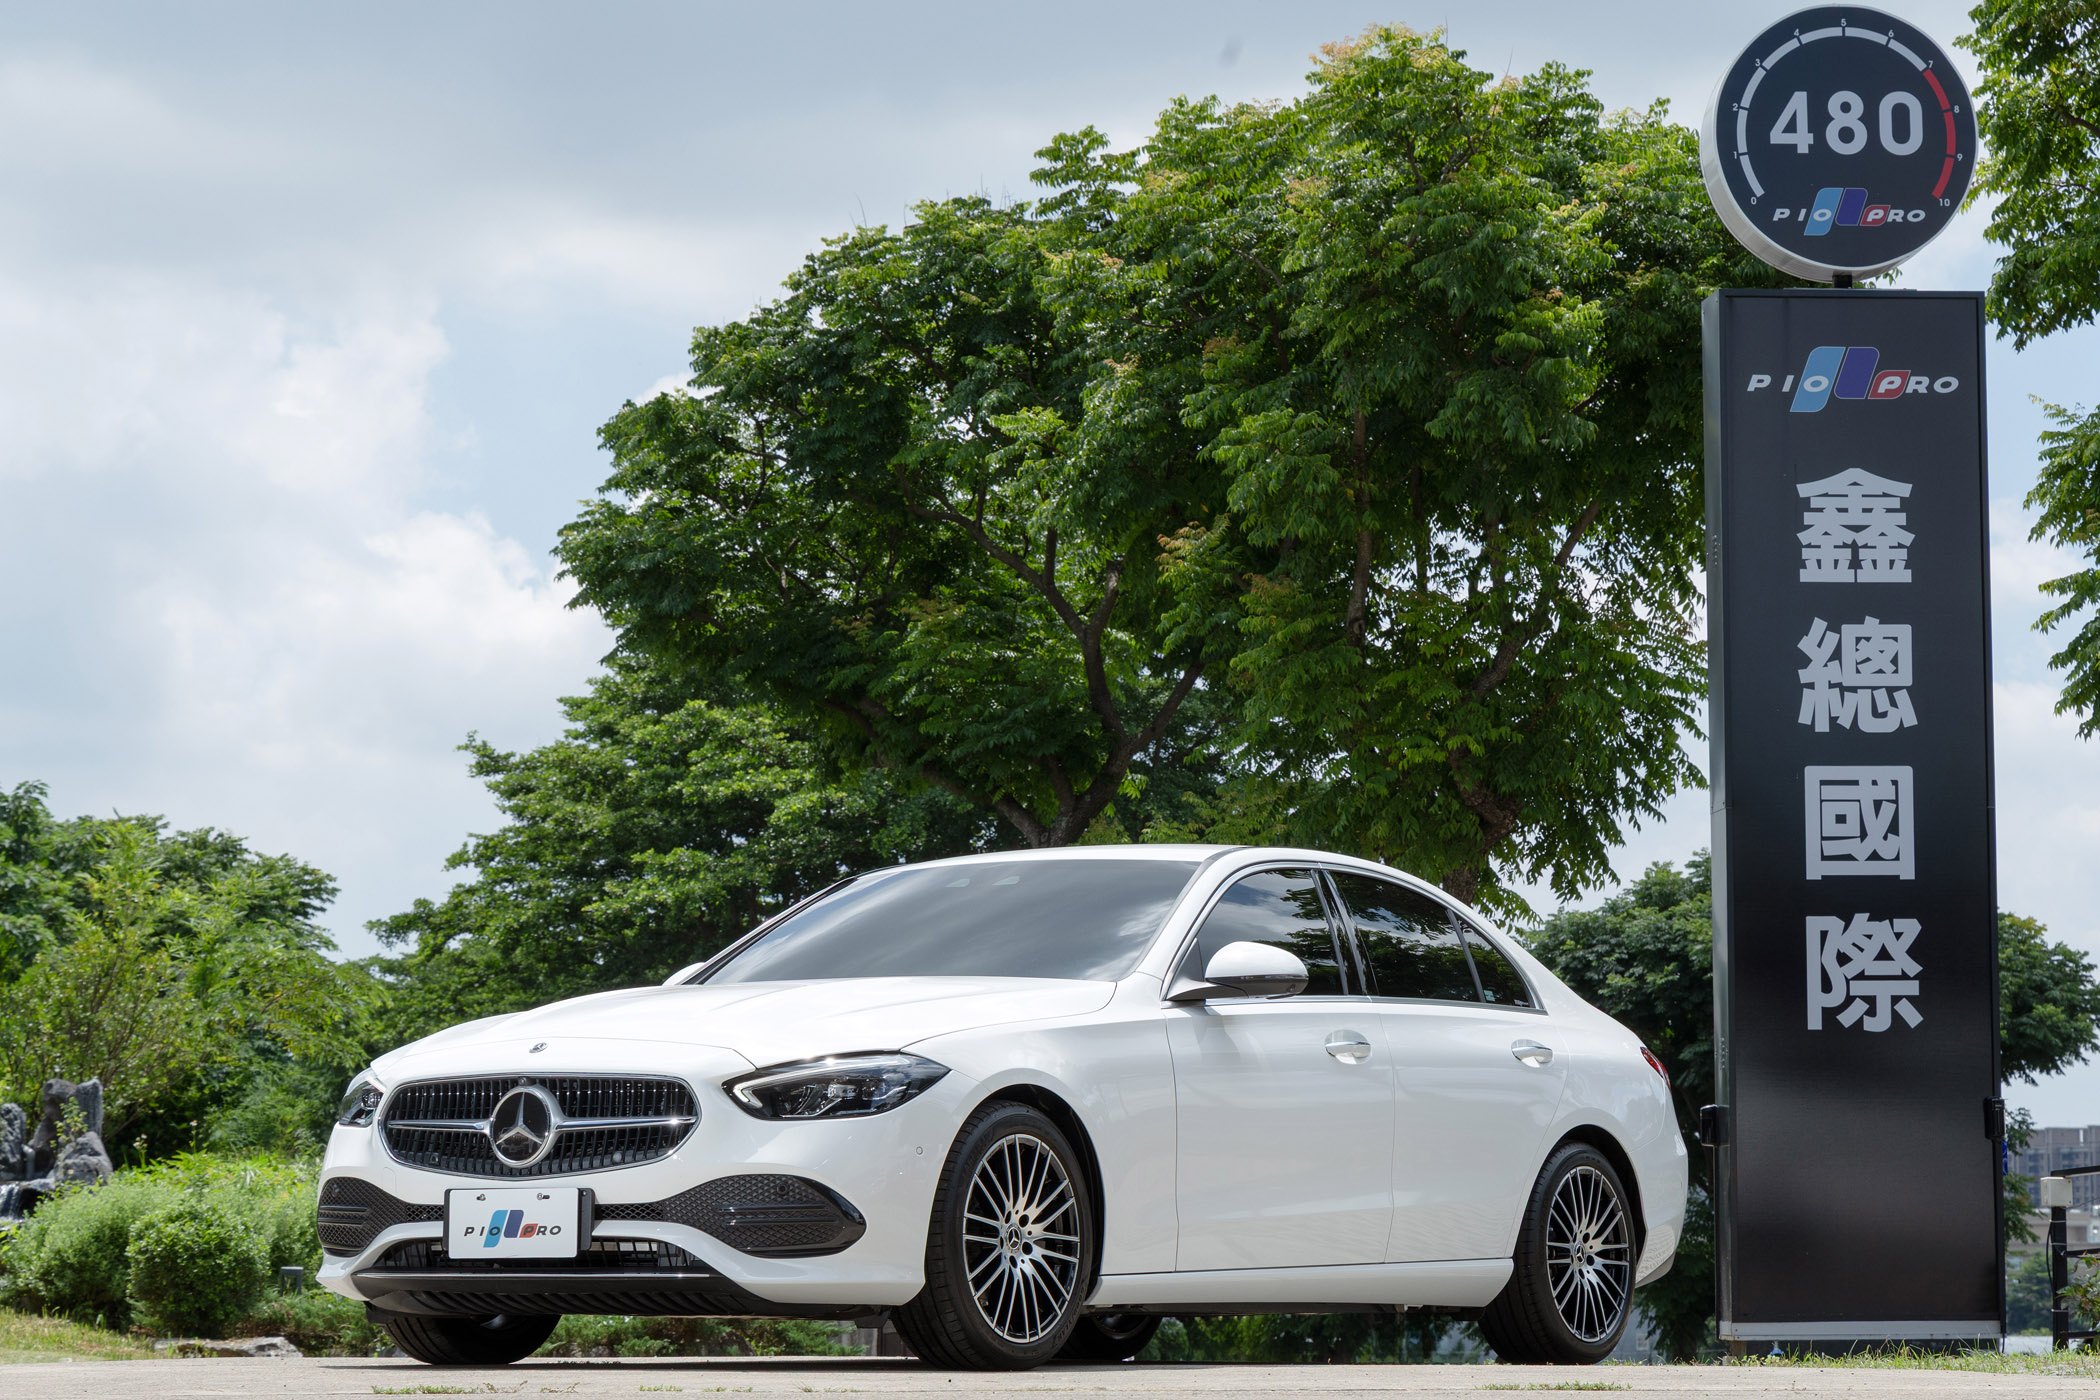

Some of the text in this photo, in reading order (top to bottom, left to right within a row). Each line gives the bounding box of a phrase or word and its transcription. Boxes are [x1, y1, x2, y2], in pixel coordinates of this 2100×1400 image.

[1794, 28, 1799, 37] 4
[1888, 29, 1894, 37] 6
[1755, 59, 1760, 67] 3
[1733, 103, 1738, 111] 2
[1954, 105, 1959, 113] 8
[1770, 91, 1923, 155] 480
[1734, 151, 1737, 159] 1
[1957, 153, 1963, 161] 9
[1751, 197, 1757, 205] 0
[1796, 468, 1923, 1032] 鑫總國際
